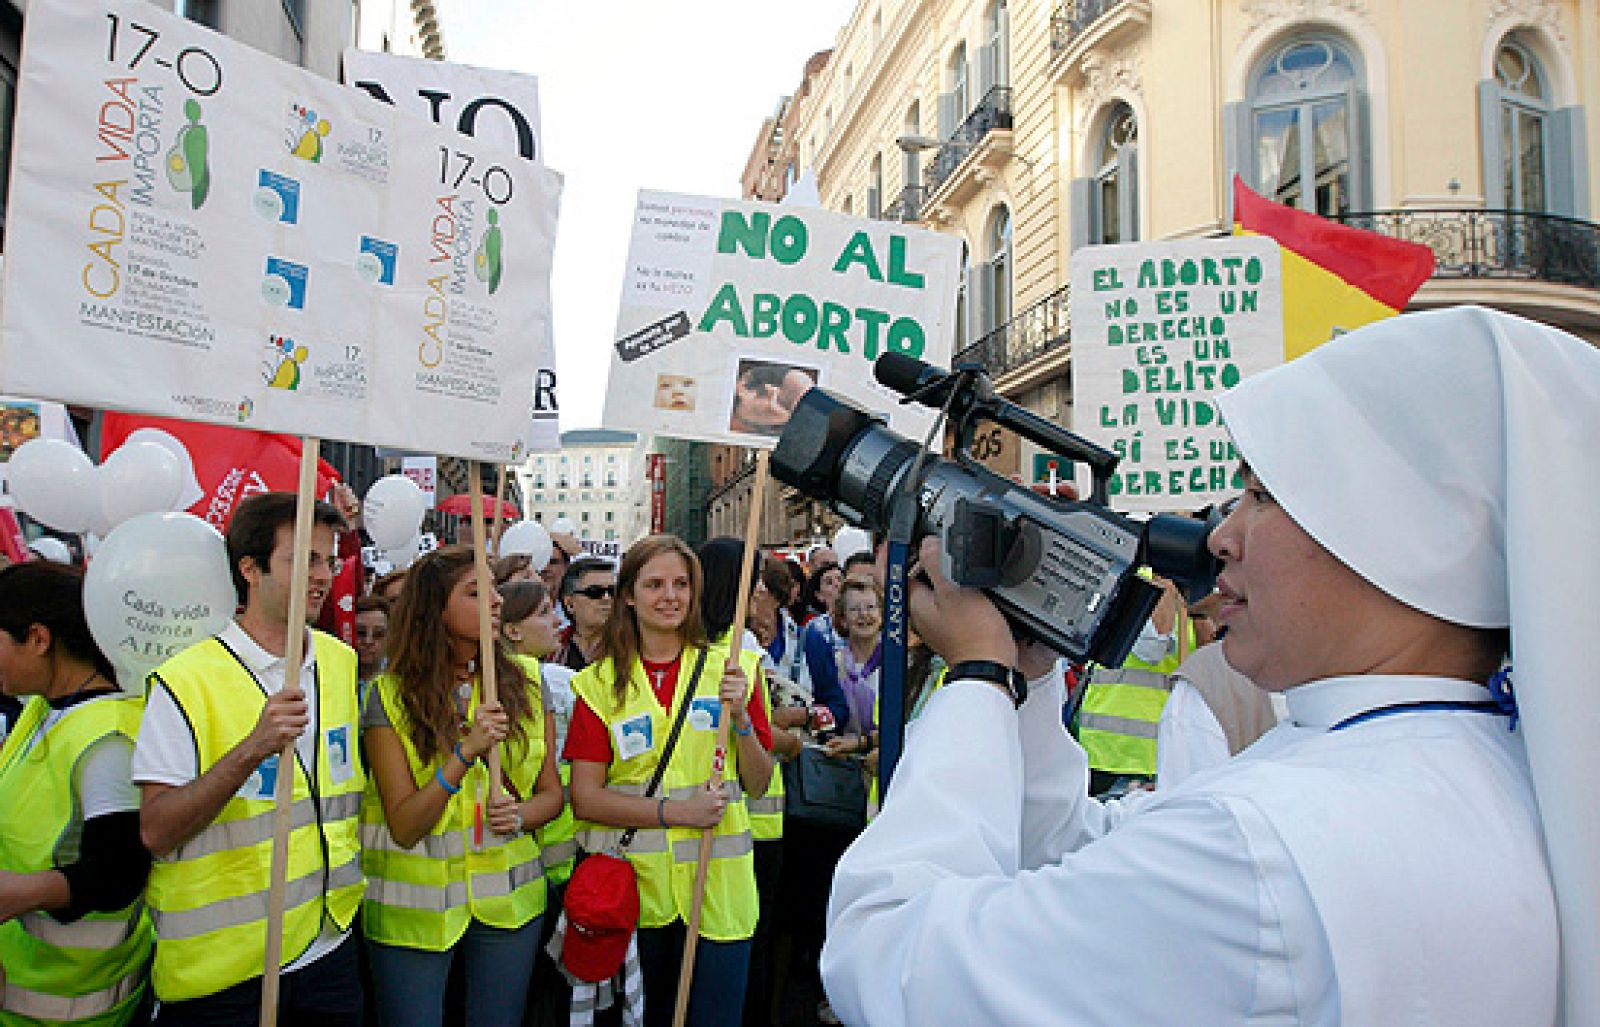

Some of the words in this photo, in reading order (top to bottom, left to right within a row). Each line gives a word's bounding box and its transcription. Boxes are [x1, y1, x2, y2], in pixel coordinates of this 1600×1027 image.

[96, 78, 138, 163] VIDA
[131, 86, 164, 208] IMPORTA
[82, 181, 129, 299] CADA
[430, 195, 460, 263] VIDA
[450, 200, 475, 295] IMPORTA
[718, 211, 808, 264] NO
[833, 231, 925, 289] AL
[1093, 267, 1123, 291] EL
[1137, 257, 1262, 288] ABORTO
[1105, 297, 1138, 319] NO
[1155, 290, 1189, 314] ES
[1219, 290, 1257, 314] UN
[418, 275, 449, 368] CADA
[698, 283, 926, 361] ABORTO
[1108, 316, 1226, 346] DERECHO
[1136, 345, 1168, 364] ES
[1195, 339, 1231, 361] UN
[1123, 360, 1240, 393] DELITO
[1101, 403, 1138, 426] LA
[1166, 436, 1199, 461] ES
